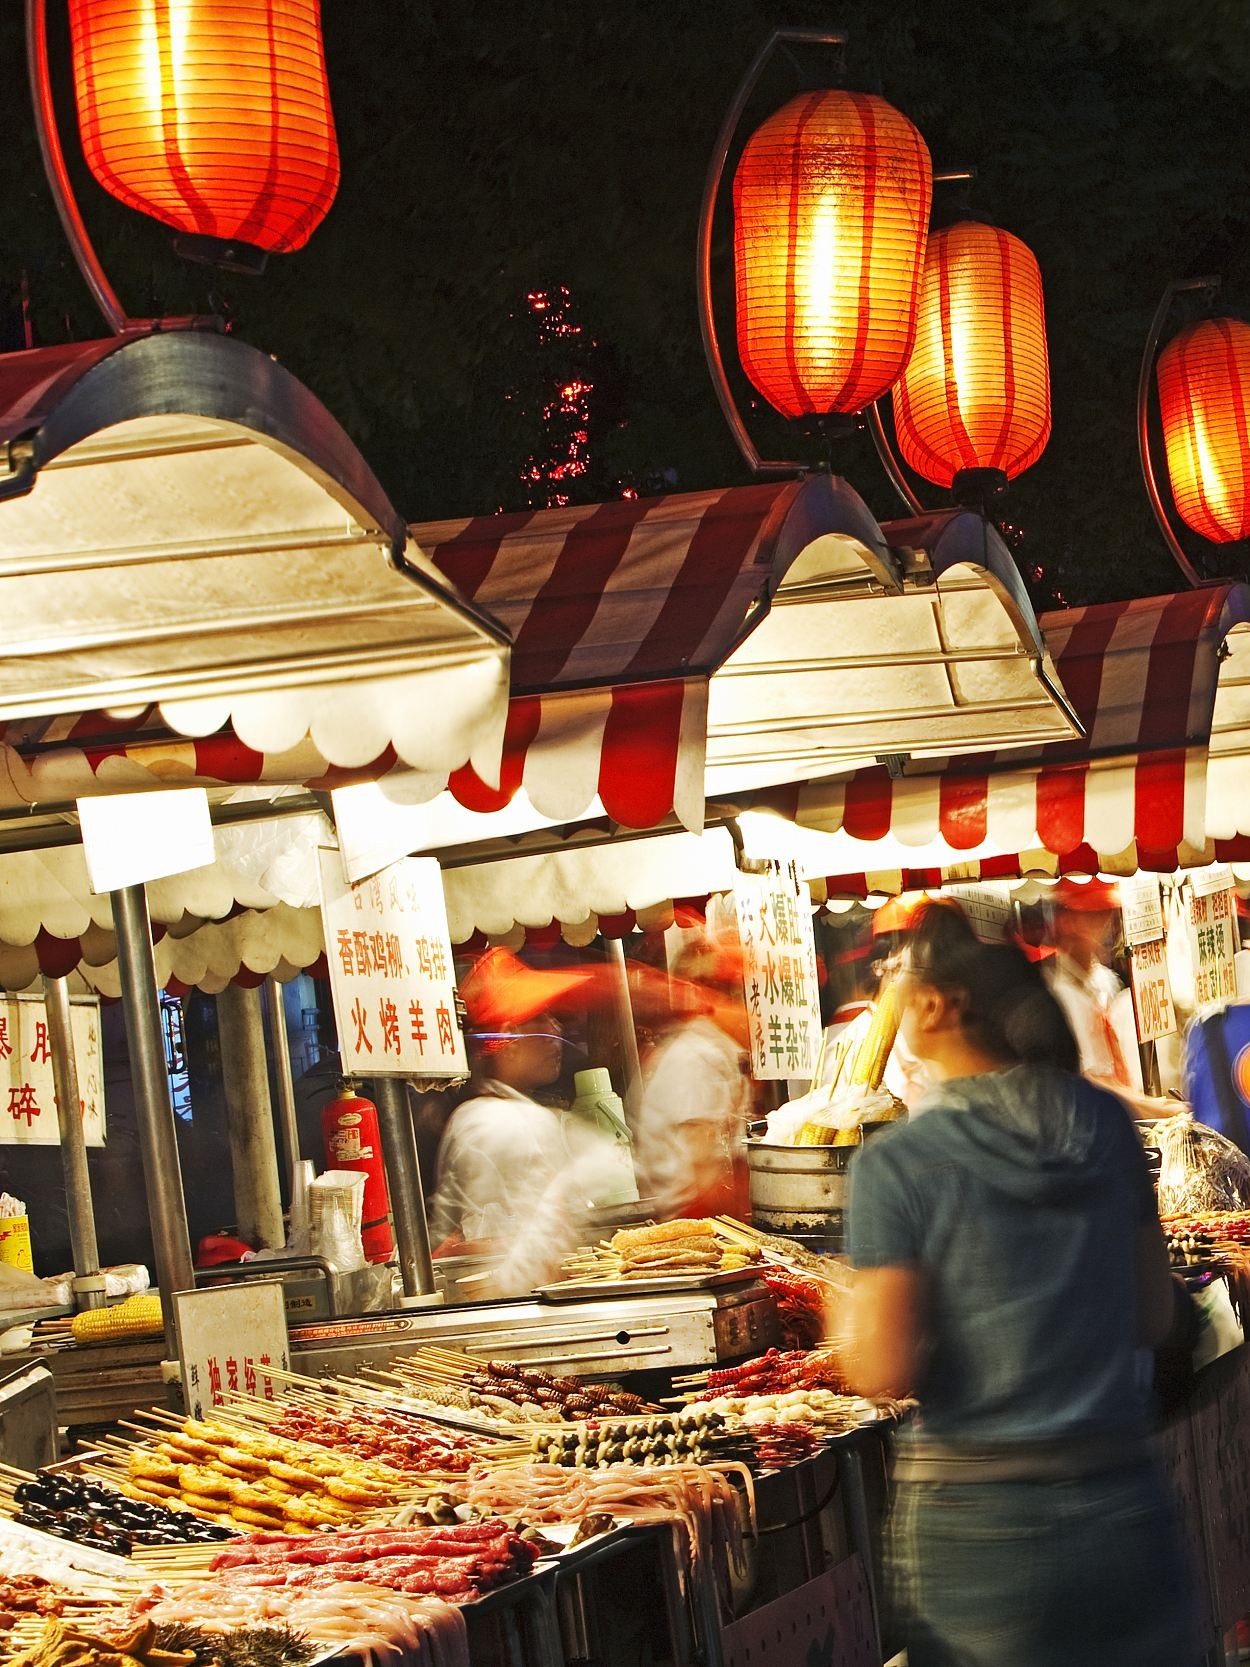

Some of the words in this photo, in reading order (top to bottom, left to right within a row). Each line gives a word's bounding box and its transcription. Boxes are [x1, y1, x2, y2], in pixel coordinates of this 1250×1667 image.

[337, 928, 447, 981] 香酥鸡柳、鸡排
[1198, 923, 1226, 966] 麻辣烫
[761, 951, 808, 1008] 水爆肚
[351, 997, 456, 1056] 火烤羊肉
[768, 1014, 812, 1072] 羊杂汤
[207, 1353, 274, 1407] 独家经营
